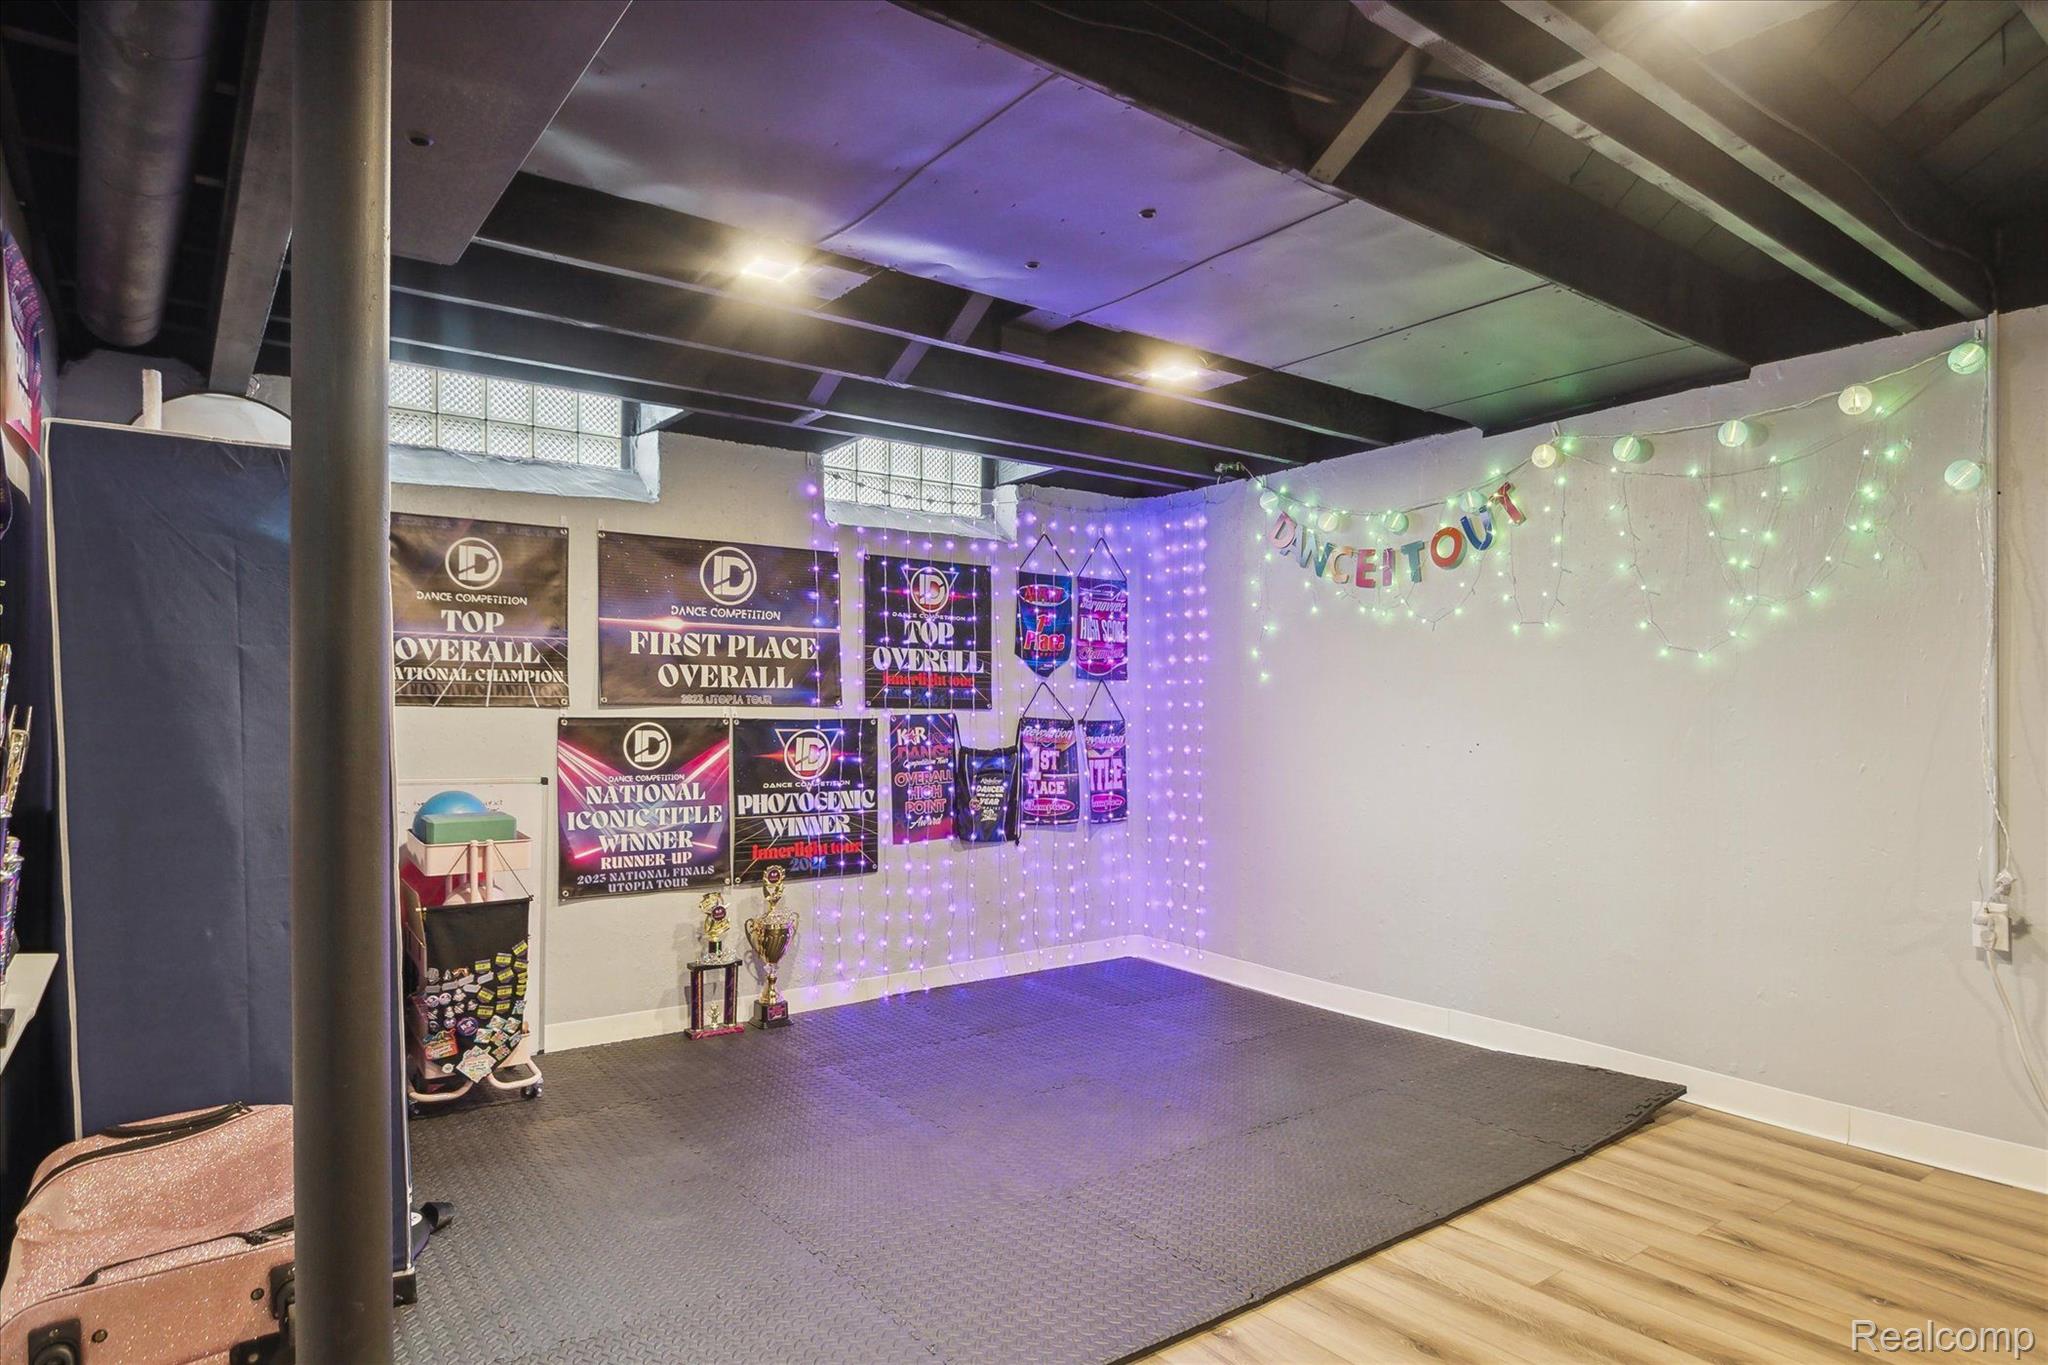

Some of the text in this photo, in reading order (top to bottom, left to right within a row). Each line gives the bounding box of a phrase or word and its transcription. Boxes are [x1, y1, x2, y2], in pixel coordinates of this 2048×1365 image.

[416, 591, 528, 606] DANCE COMPETITION
[441, 609, 505, 634] TOP
[671, 605, 781, 621] DANCE COMPETITION
[904, 620, 955, 646] TOP
[1024, 630, 1066, 652] Place
[395, 637, 541, 664] OVERALL
[629, 631, 818, 660] FIRST PLACE
[873, 646, 984, 674] OVERALL
[394, 667, 564, 683] ATIONAL CHAMPION
[657, 663, 793, 689] OVERALL
[706, 694, 744, 705] UTOPIA
[746, 694, 772, 705] TOUR
[609, 774, 685, 783] DANCE COMPETITION
[894, 770, 954, 787] OVERALL
[1027, 780, 1066, 795] PLACE
[585, 782, 706, 805] NATIONAL
[737, 789, 876, 815] PHOTOGENIC
[908, 784, 943, 800] HIGH
[905, 799, 947, 815] POINT
[567, 805, 722, 831] ICONIC TITLE
[764, 814, 850, 839] WINNER
[599, 830, 694, 853] WINNER
[600, 851, 693, 870] RUNNER-UP
[609, 869, 670, 882] NATIONAL
[673, 865, 715, 877] FINALS
[608, 877, 689, 893] UTOPIA TOUR
